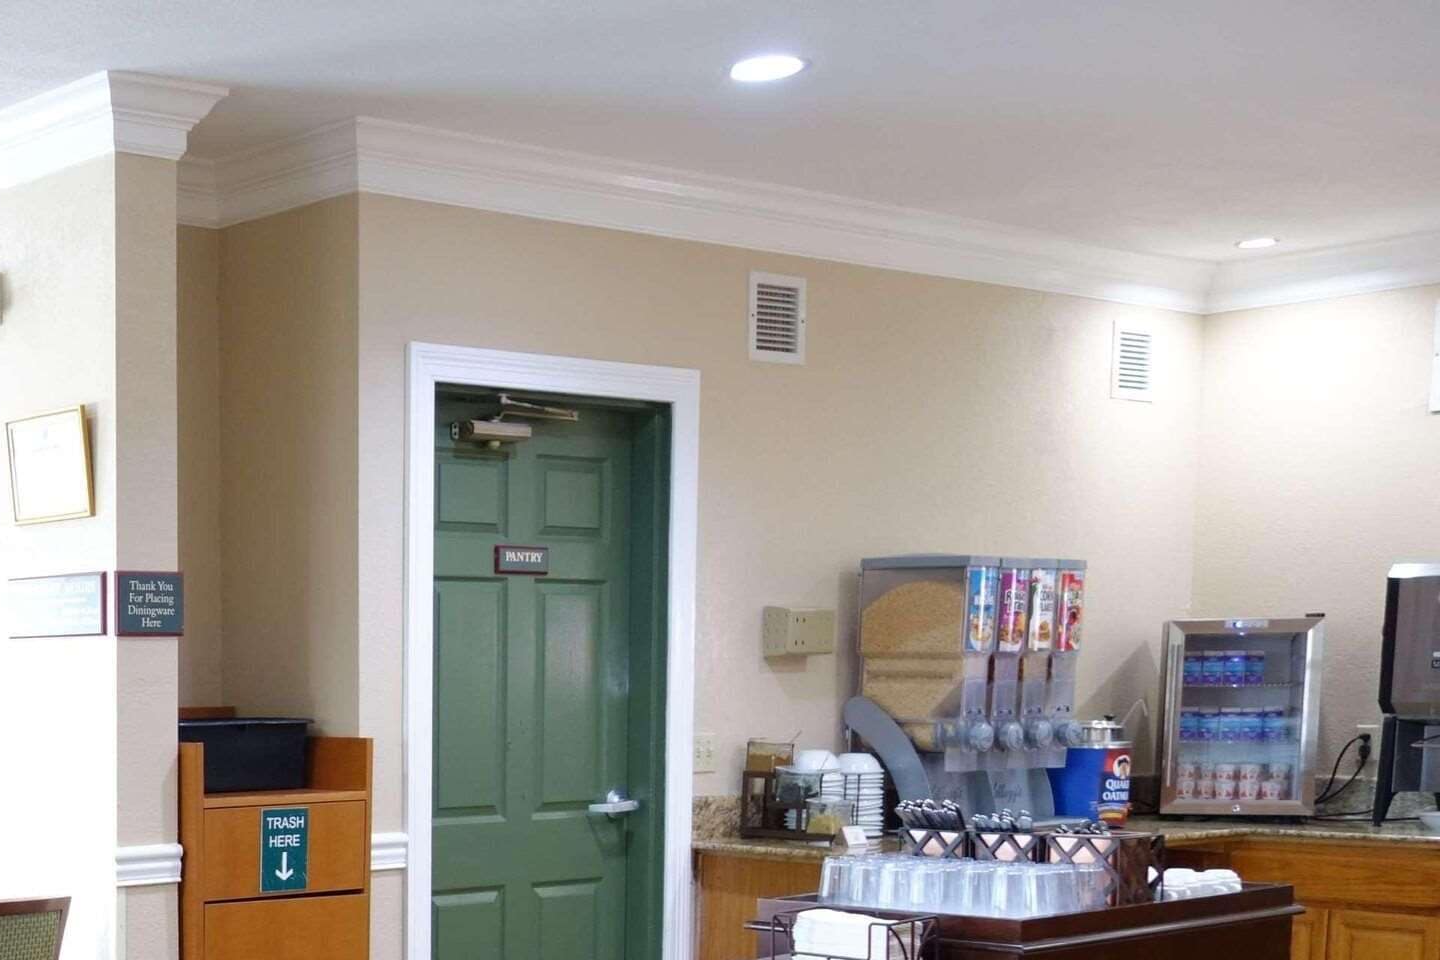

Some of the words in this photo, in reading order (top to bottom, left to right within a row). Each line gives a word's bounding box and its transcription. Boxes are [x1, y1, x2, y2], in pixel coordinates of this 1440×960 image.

[505, 551, 543, 563] PANTRY
[129, 580, 156, 591] Thank
[157, 581, 174, 591] You
[129, 592, 144, 603] For
[145, 593, 174, 605] Placing
[128, 605, 175, 617] Diningware
[142, 618, 162, 627] Here
[266, 816, 305, 829] TRASH
[269, 834, 301, 848] HERE
